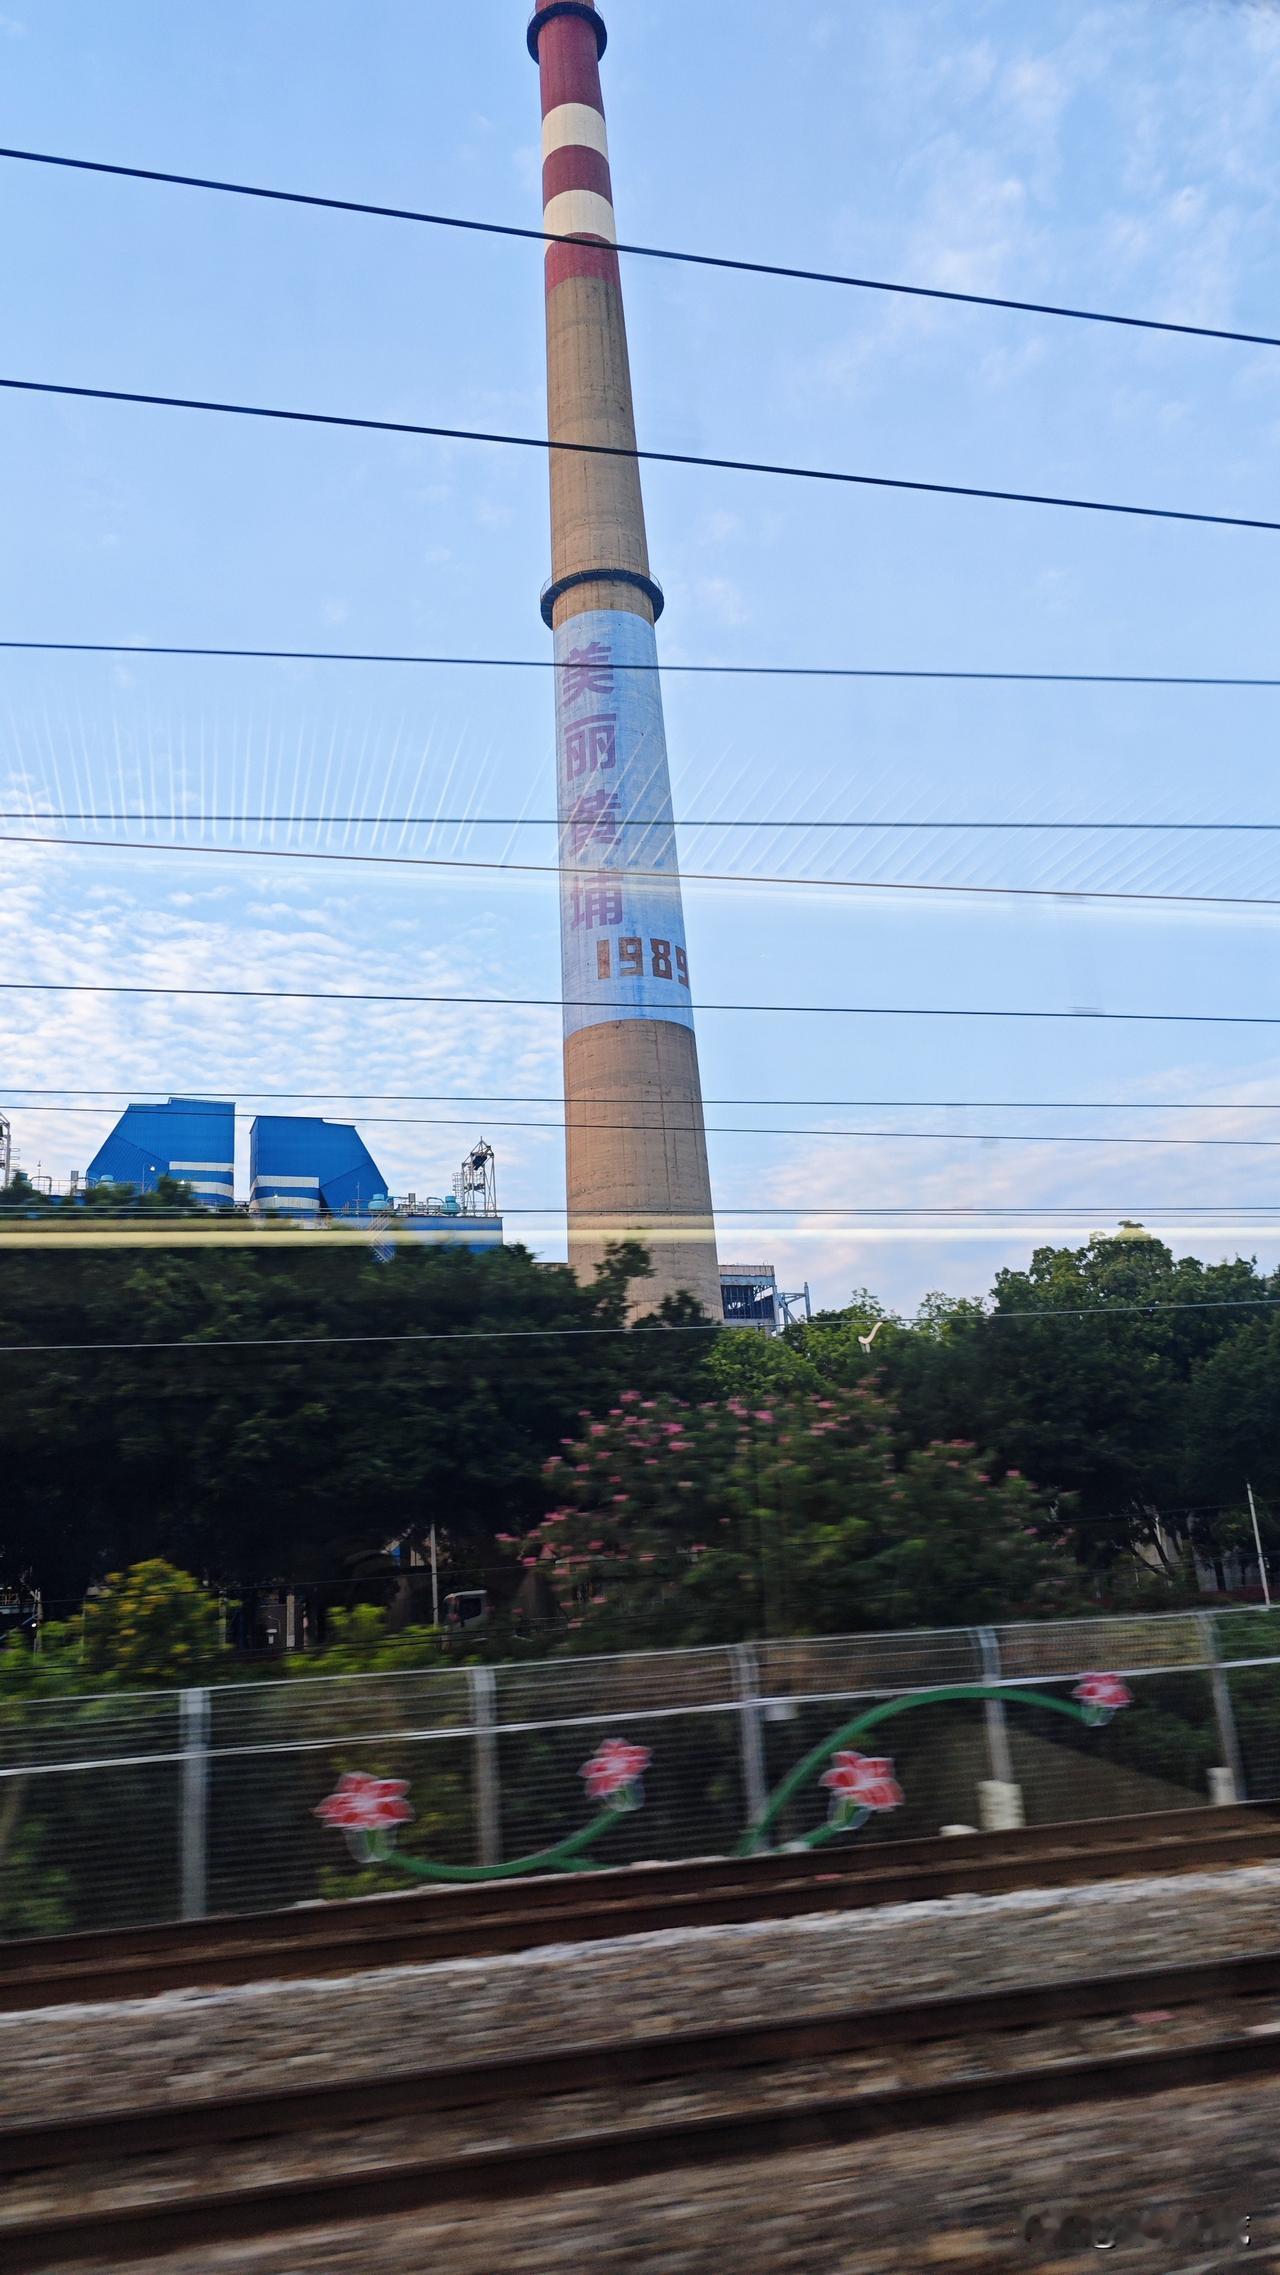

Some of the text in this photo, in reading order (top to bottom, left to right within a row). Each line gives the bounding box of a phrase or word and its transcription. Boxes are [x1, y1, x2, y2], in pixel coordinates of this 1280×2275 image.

[562, 641, 623, 930] 美丽黄埔
[597, 936, 690, 988] 1989
